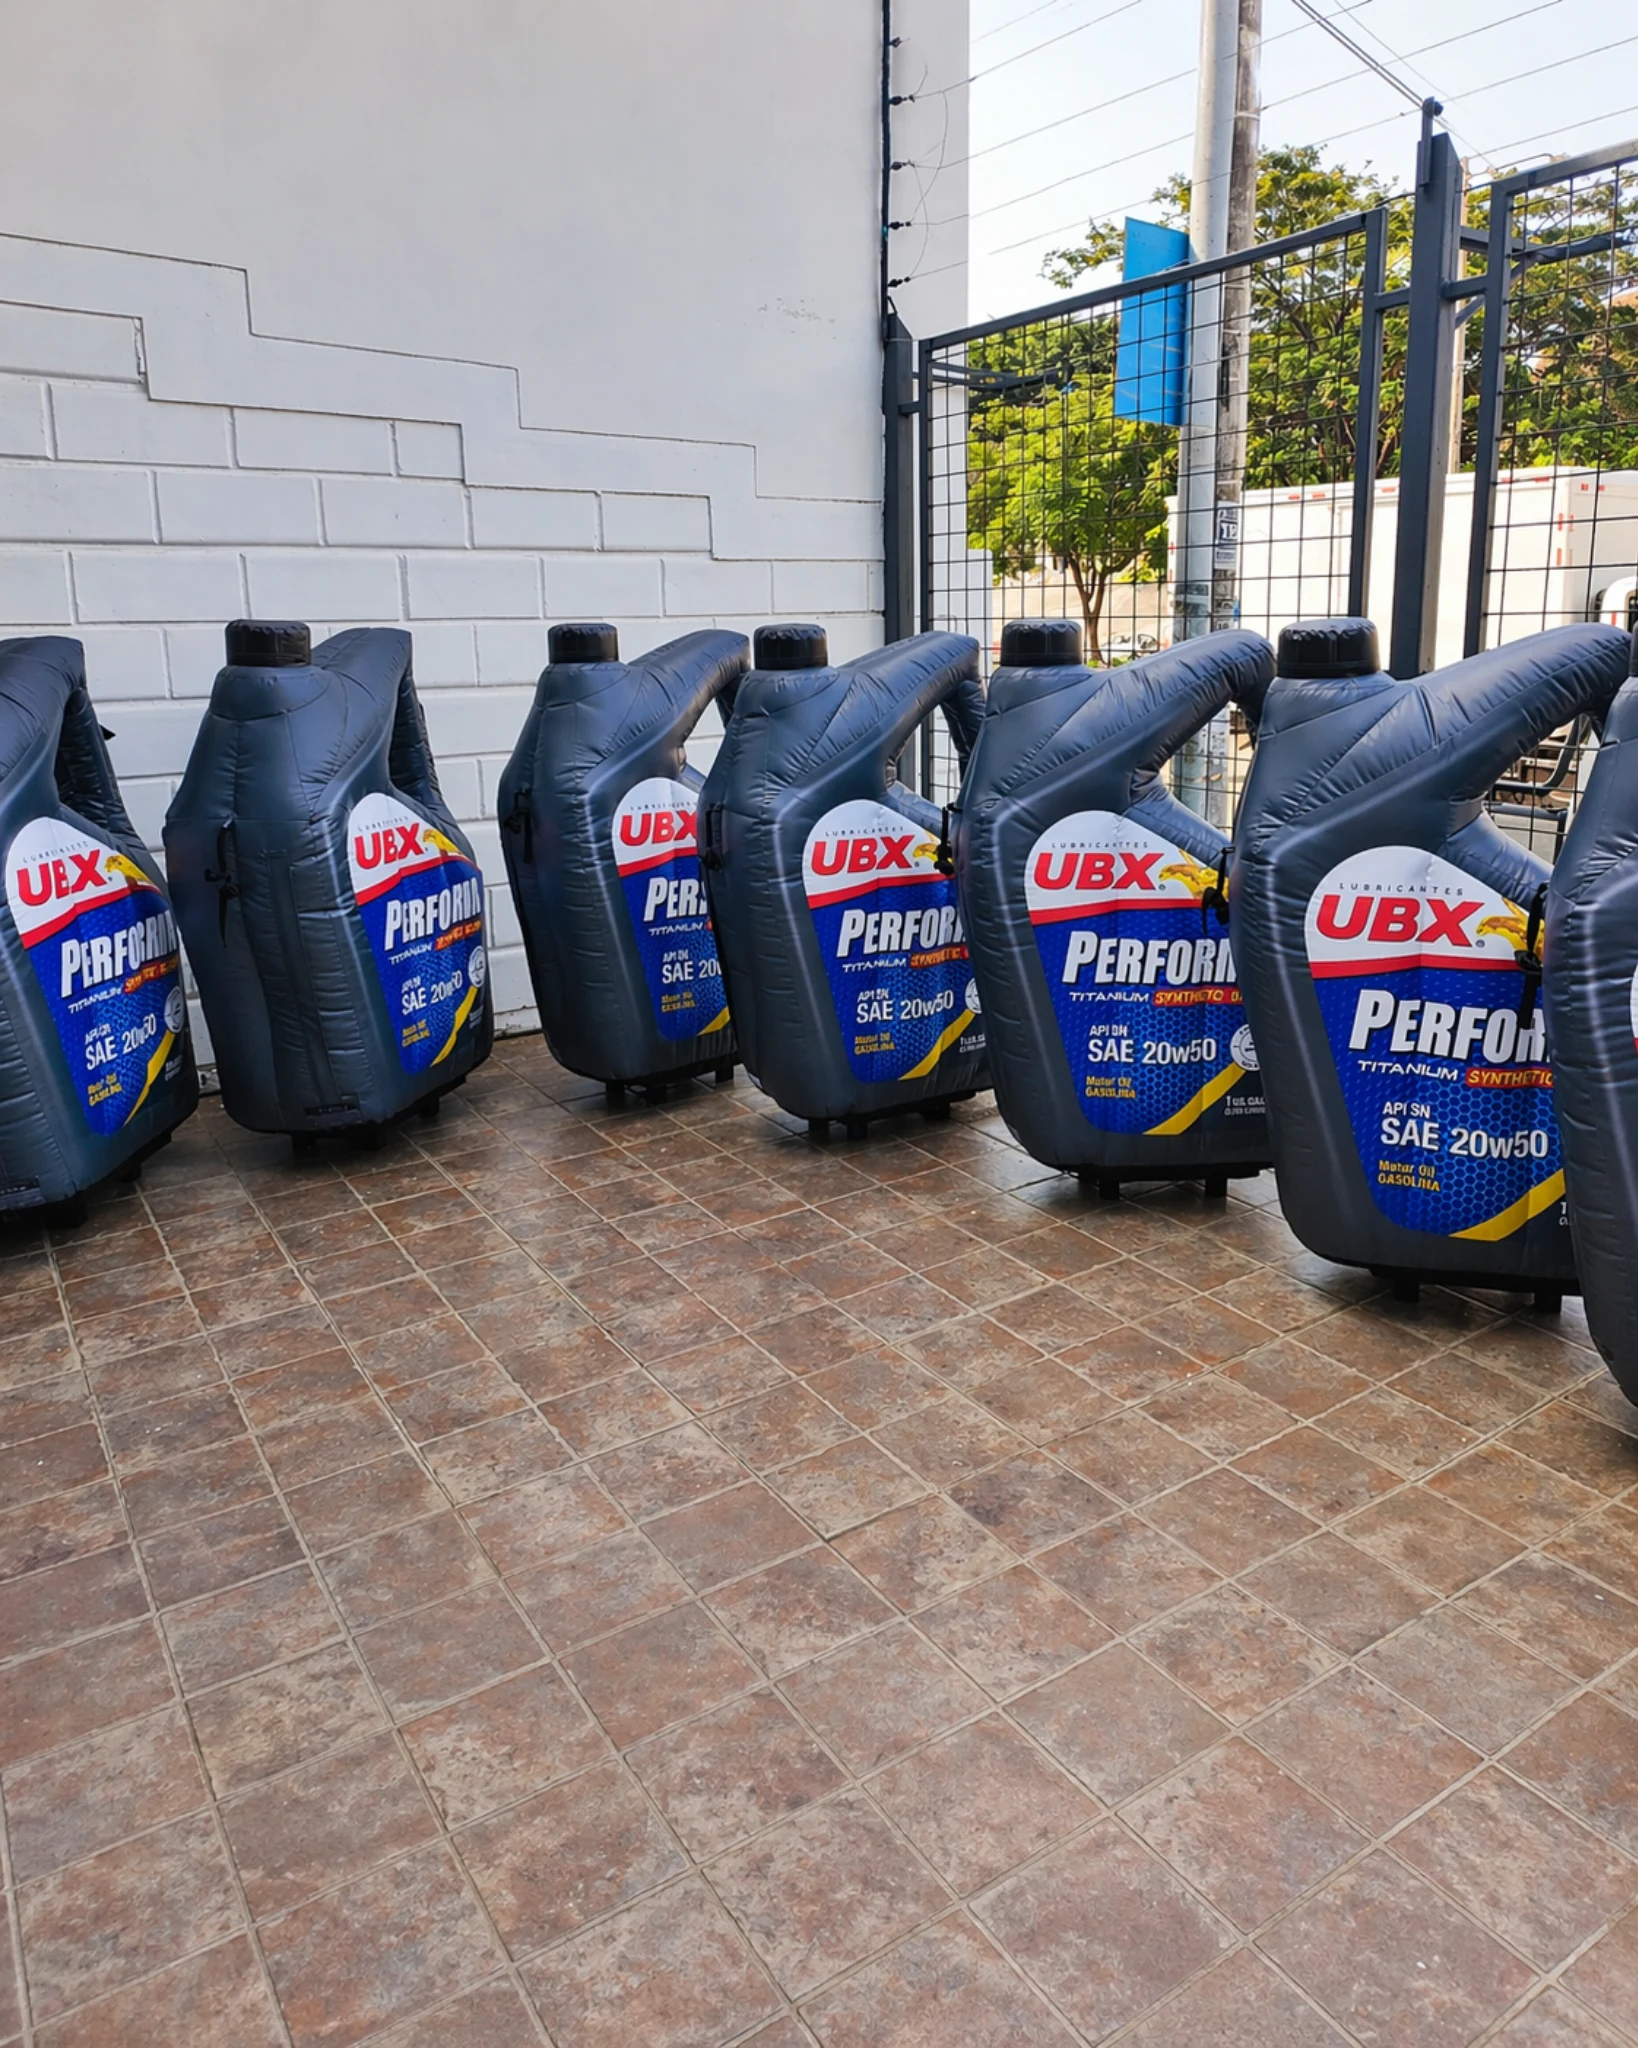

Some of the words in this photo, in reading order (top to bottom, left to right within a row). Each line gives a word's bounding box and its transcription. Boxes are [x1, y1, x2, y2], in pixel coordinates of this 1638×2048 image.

[620, 810, 698, 846] UBX
[355, 823, 424, 869] UBX
[811, 835, 915, 876] UBX
[16, 849, 108, 906] UBX
[1034, 853, 1165, 890] UBX
[1339, 882, 1463, 896] LUBRICANTES
[1316, 894, 1485, 947] UBX
[662, 961, 694, 984] SAE
[842, 957, 907, 973] TITANIUM
[402, 987, 427, 1015] SAE
[856, 1000, 893, 1023] SAE
[900, 990, 954, 1020] 20w50
[1069, 991, 1149, 1002] TITANIUM
[1089, 1025, 1109, 1037] API
[1349, 989, 1550, 1063] PERFOR
[86, 1036, 118, 1070] SAE
[1088, 1038, 1134, 1062] SAE
[1142, 1038, 1217, 1064] 20w50
[1357, 1060, 1458, 1081] TITANIUM
[1383, 1101, 1407, 1116] API
[1410, 1103, 1430, 1118] SN
[1380, 1118, 1439, 1151] SAE
[1450, 1128, 1548, 1159] 20w50
[1378, 1160, 1414, 1172] Motor
[1418, 1164, 1435, 1177] Oil
[1378, 1173, 1440, 1192] GASOLINA
